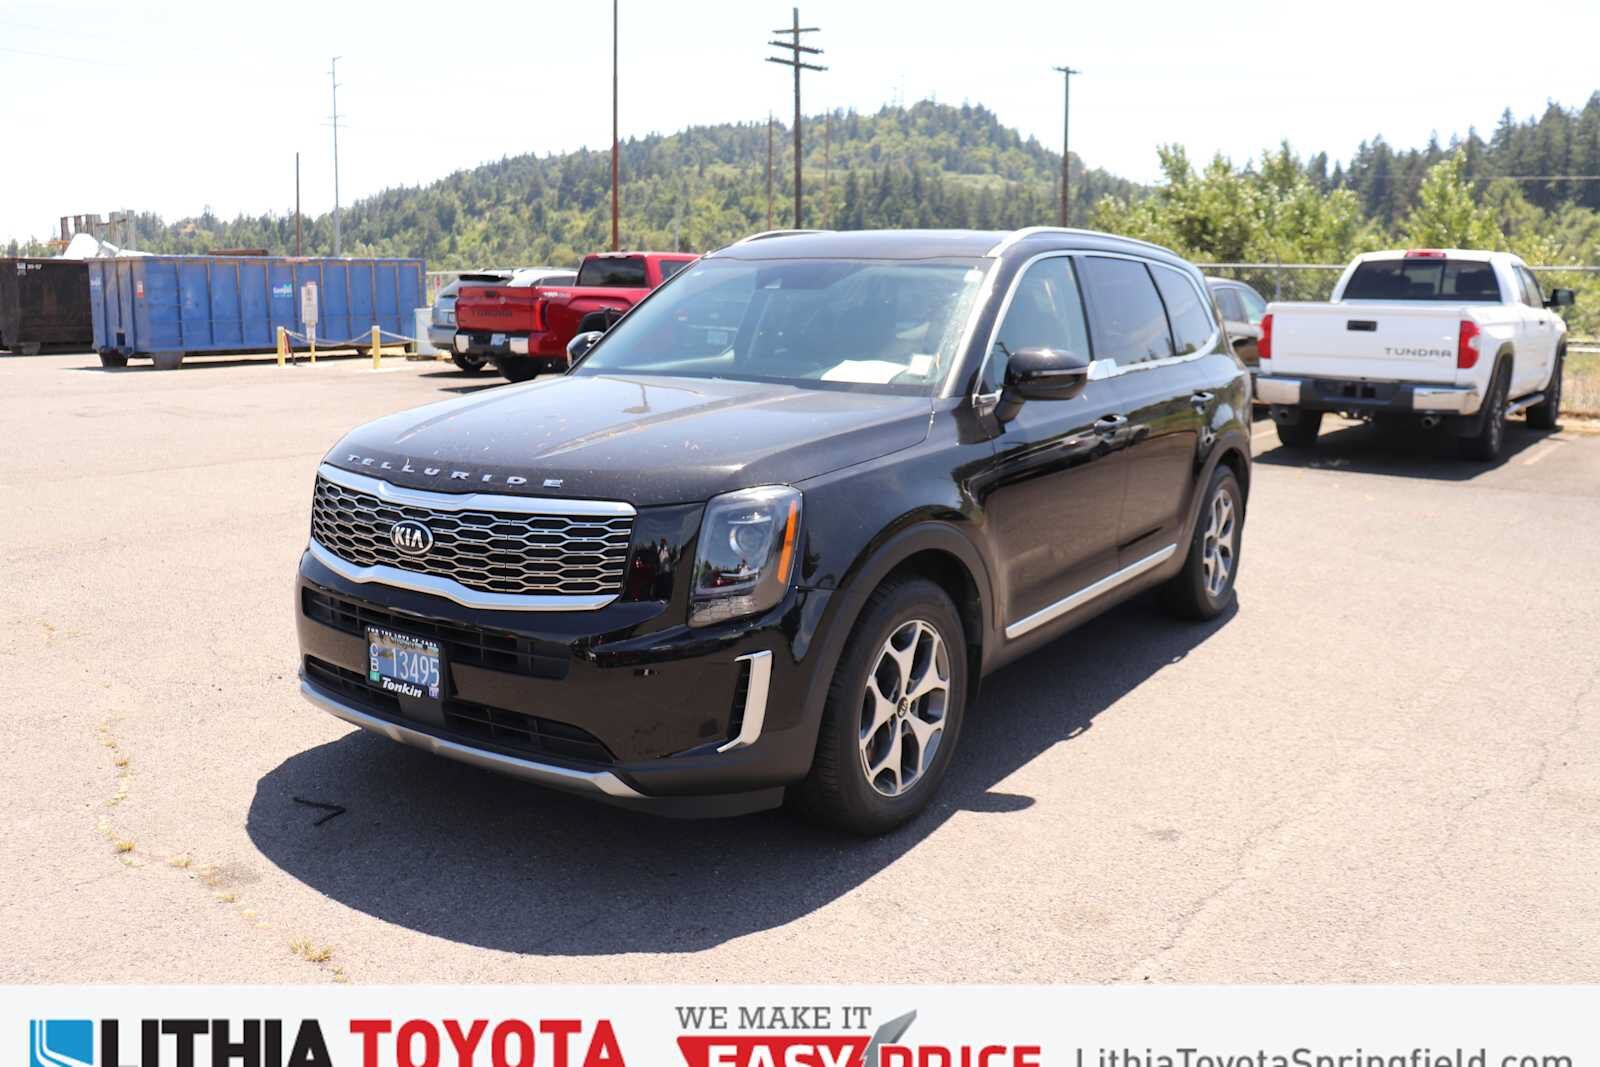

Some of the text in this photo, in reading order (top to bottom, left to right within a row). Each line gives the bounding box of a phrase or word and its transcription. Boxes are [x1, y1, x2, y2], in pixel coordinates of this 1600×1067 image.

[1384, 347, 1452, 357] TUNDRA
[347, 454, 564, 488] TELLURIDE
[393, 526, 425, 549] KIA
[392, 648, 440, 688] 13495
[382, 677, 422, 698] Tonkin
